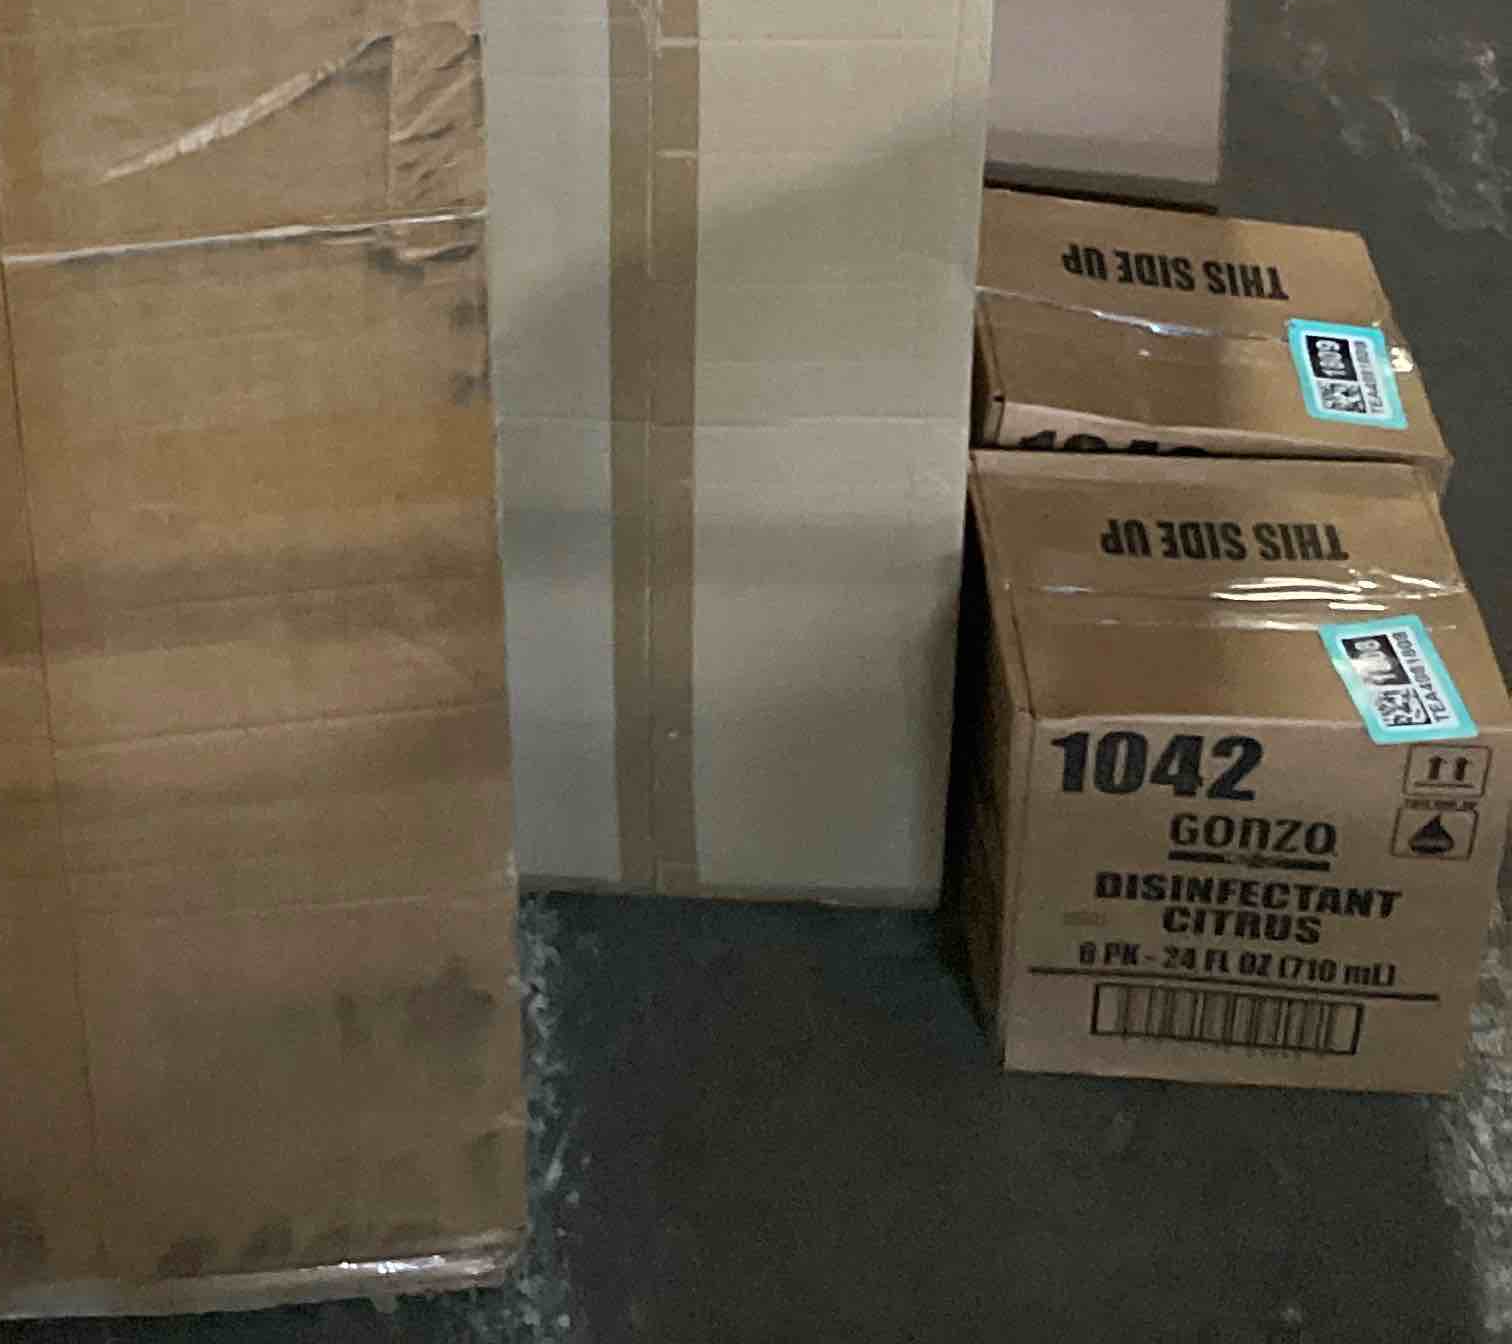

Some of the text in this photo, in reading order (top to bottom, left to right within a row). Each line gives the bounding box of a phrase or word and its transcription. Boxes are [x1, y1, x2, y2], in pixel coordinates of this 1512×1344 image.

[1062, 243, 1290, 300] THIS SIDE UP
[1100, 517, 1350, 561] THIS SIDE UP
[1050, 730, 1264, 801] 1042
[1094, 872, 1403, 919] DISINFECTANT
[1161, 906, 1322, 944] CITRUS
[1103, 942, 1141, 966] PK
[1163, 946, 1196, 970] 24
[1204, 949, 1230, 974] FL
[1238, 951, 1273, 977] OZ
